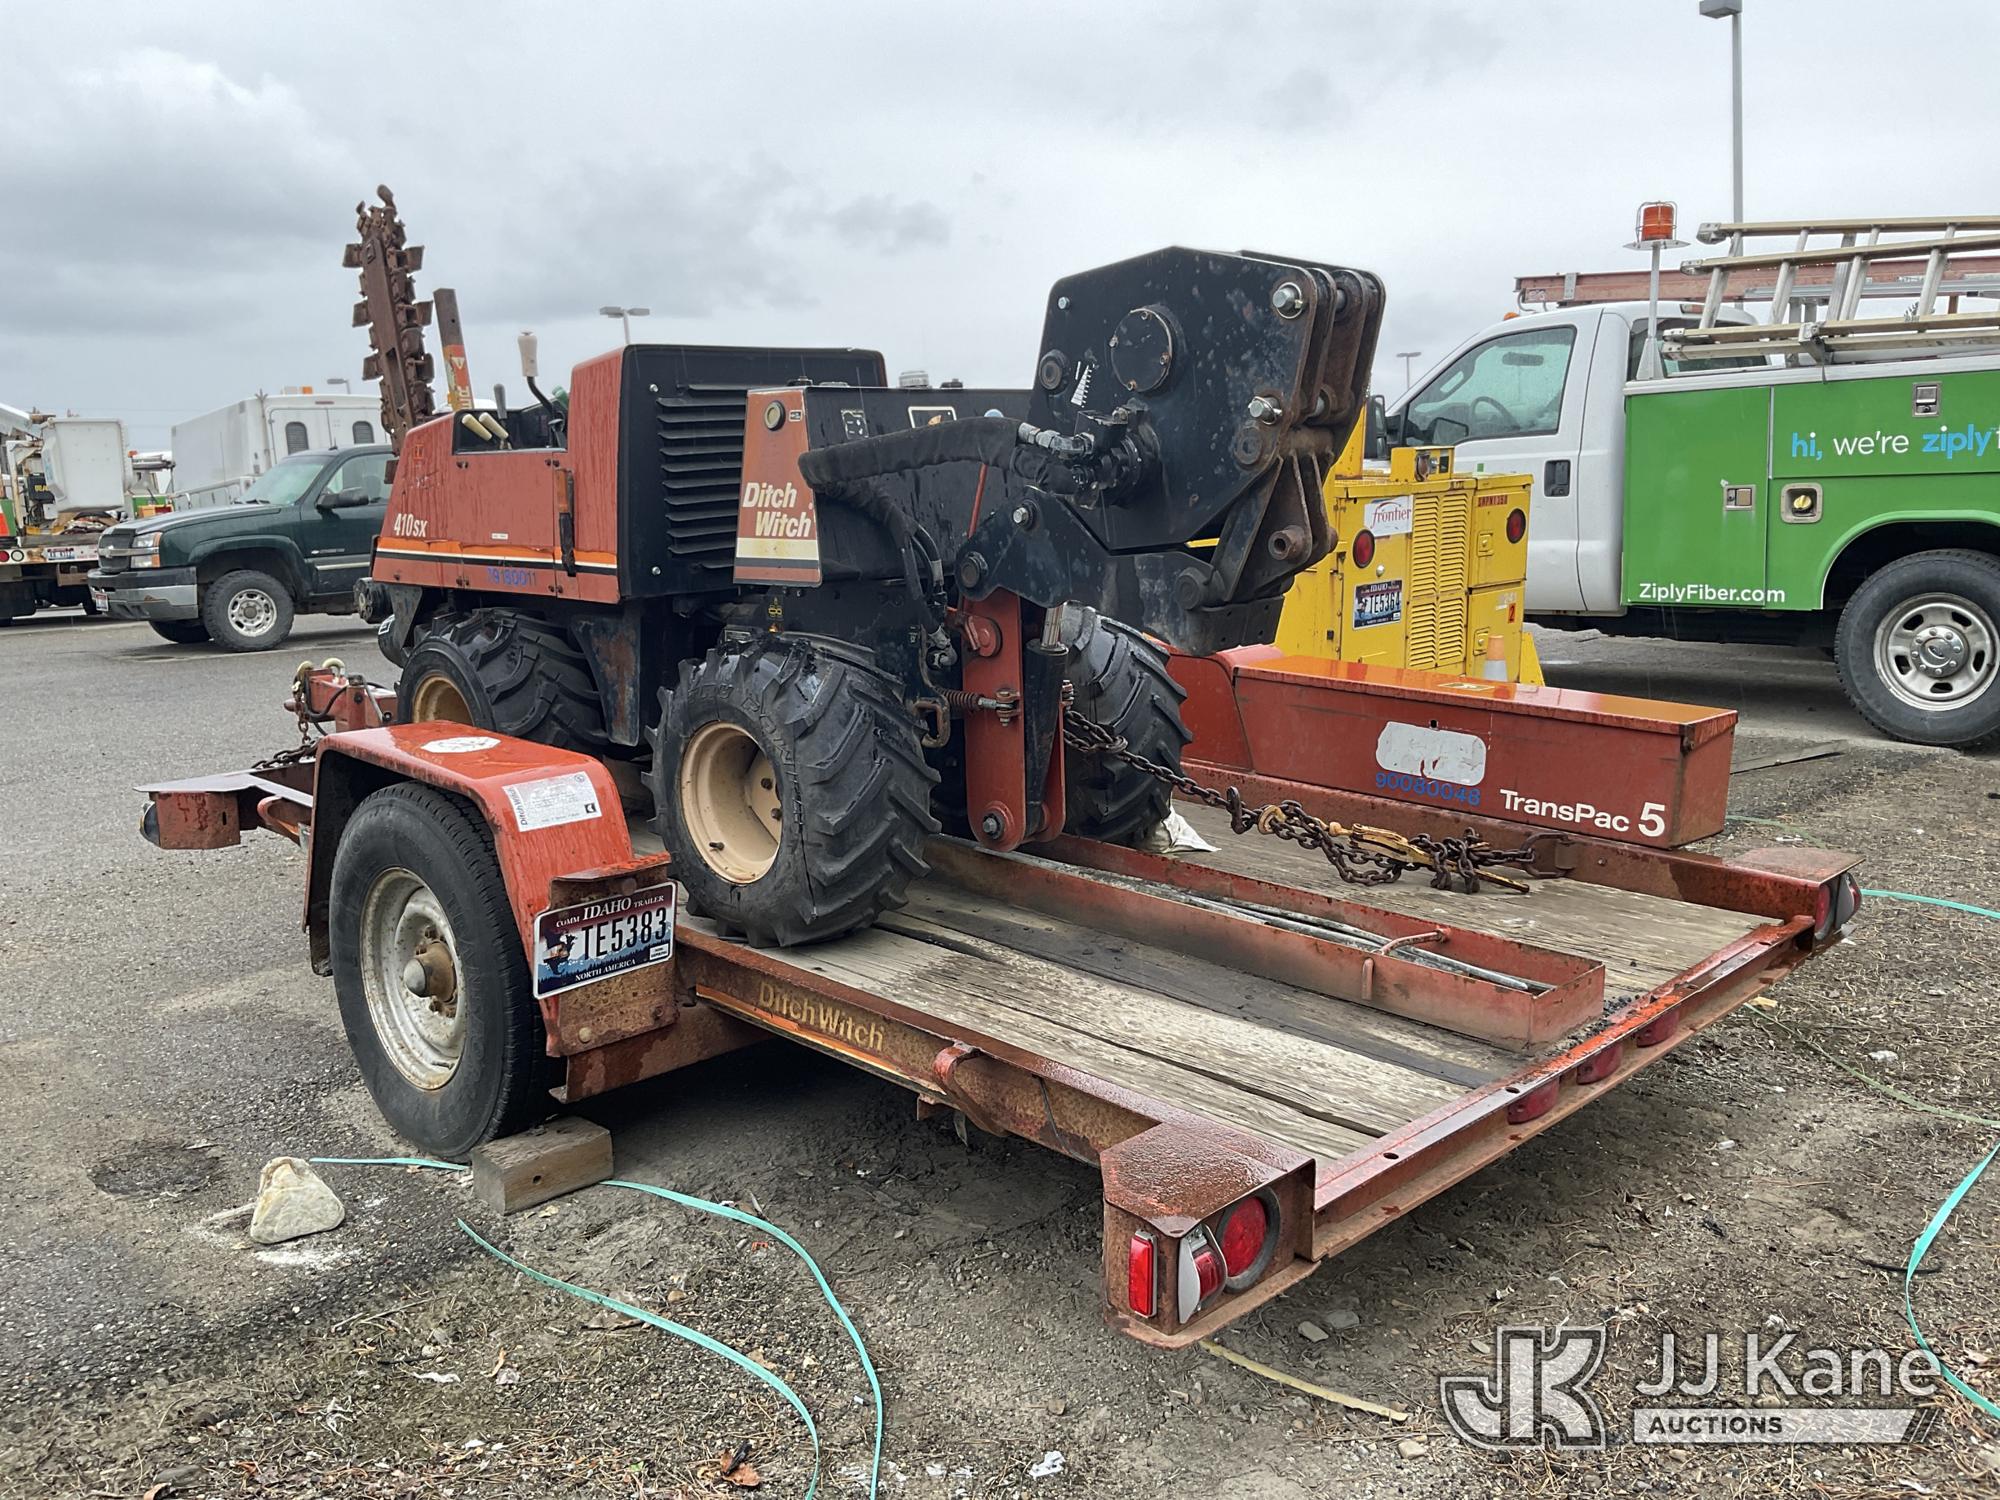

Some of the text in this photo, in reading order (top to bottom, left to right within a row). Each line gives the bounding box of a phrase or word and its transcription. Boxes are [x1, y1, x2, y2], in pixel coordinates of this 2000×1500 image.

[1791, 432, 1823, 461] hi,
[1833, 430, 1909, 456] we're
[742, 482, 797, 508] Ditch
[755, 511, 811, 537] Witch
[1371, 502, 1412, 529] frontier
[1370, 591, 1400, 614] TE5364
[1639, 583, 1785, 603] ZiplyFiber.com
[1500, 788, 1666, 838] TransPac 5
[556, 895, 664, 928] COMM IDAHO TRAILER
[581, 907, 667, 960] TE5383
[575, 958, 636, 982] NORTH AMERICA
